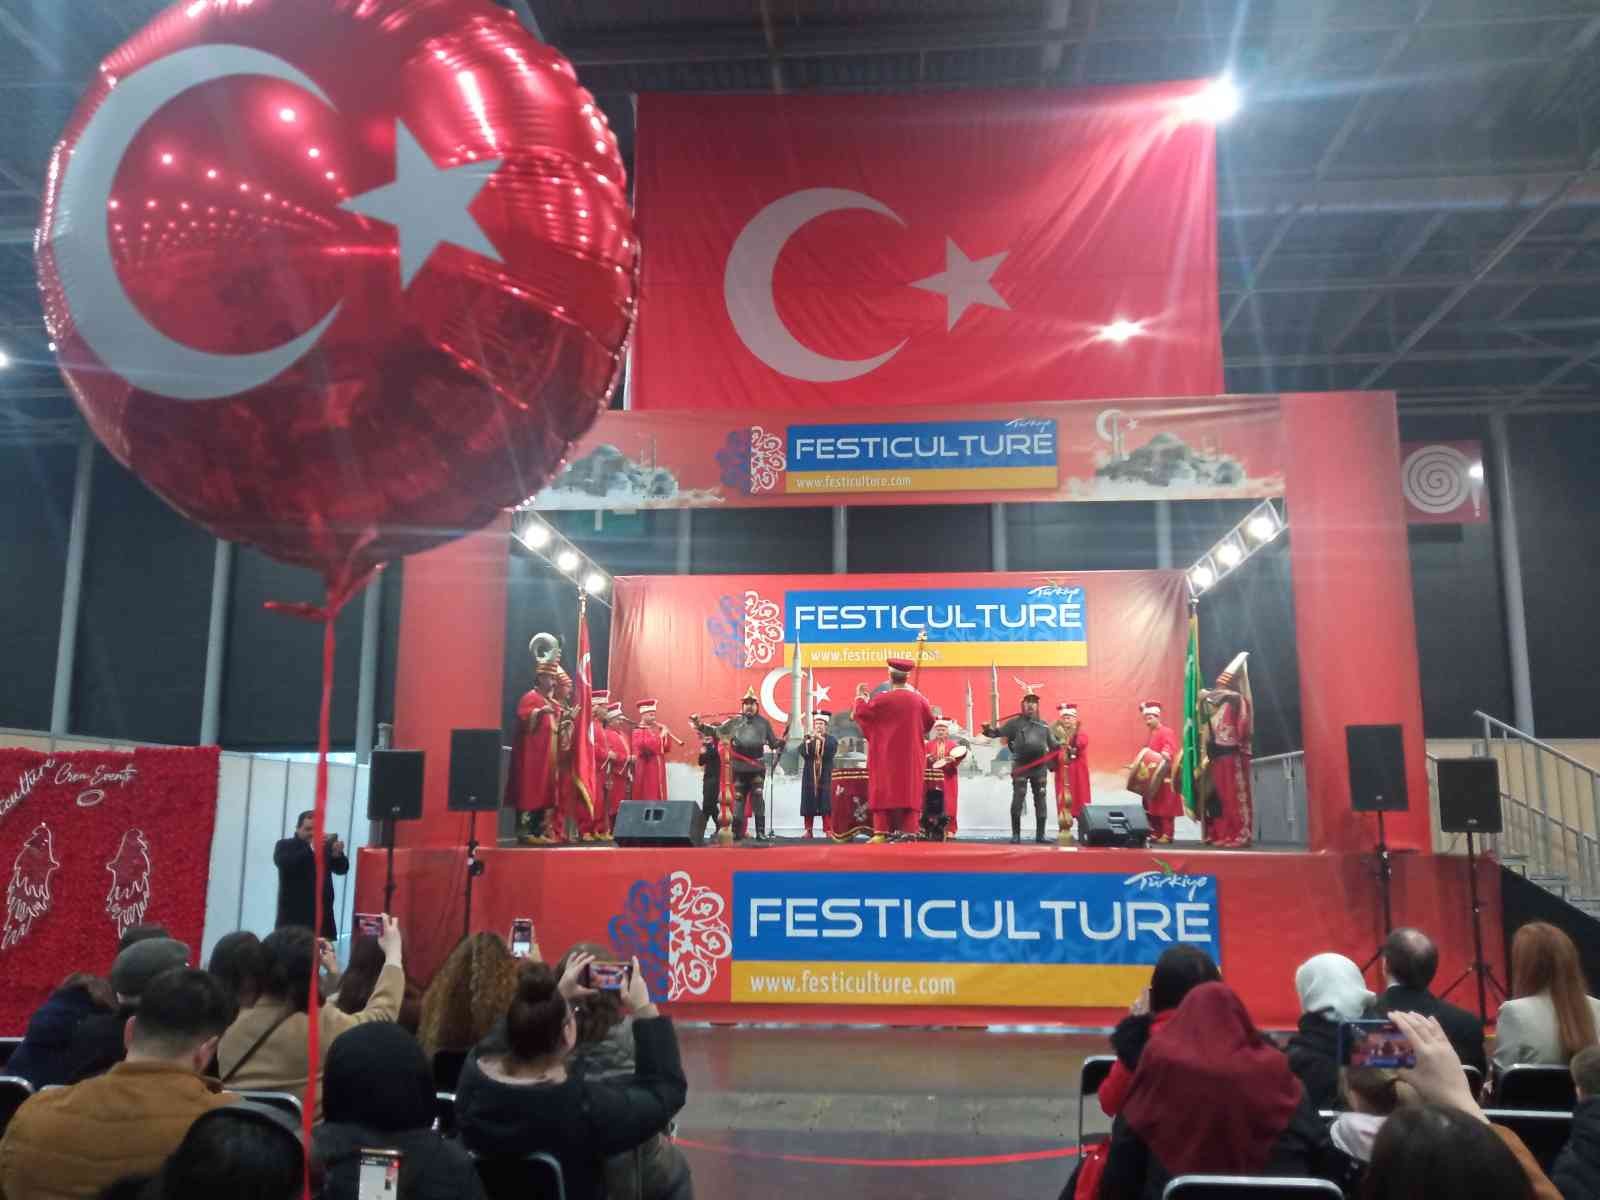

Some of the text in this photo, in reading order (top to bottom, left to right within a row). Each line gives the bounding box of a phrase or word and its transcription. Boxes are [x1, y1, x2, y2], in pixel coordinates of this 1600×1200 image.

[796, 433, 1053, 460] FESTICULTURE
[797, 474, 912, 489] www.festiculture.com
[795, 603, 1081, 630] FESTICULTURE
[750, 897, 1212, 942] FESTICULTURE
[750, 970, 956, 995] www.festiculture.com
